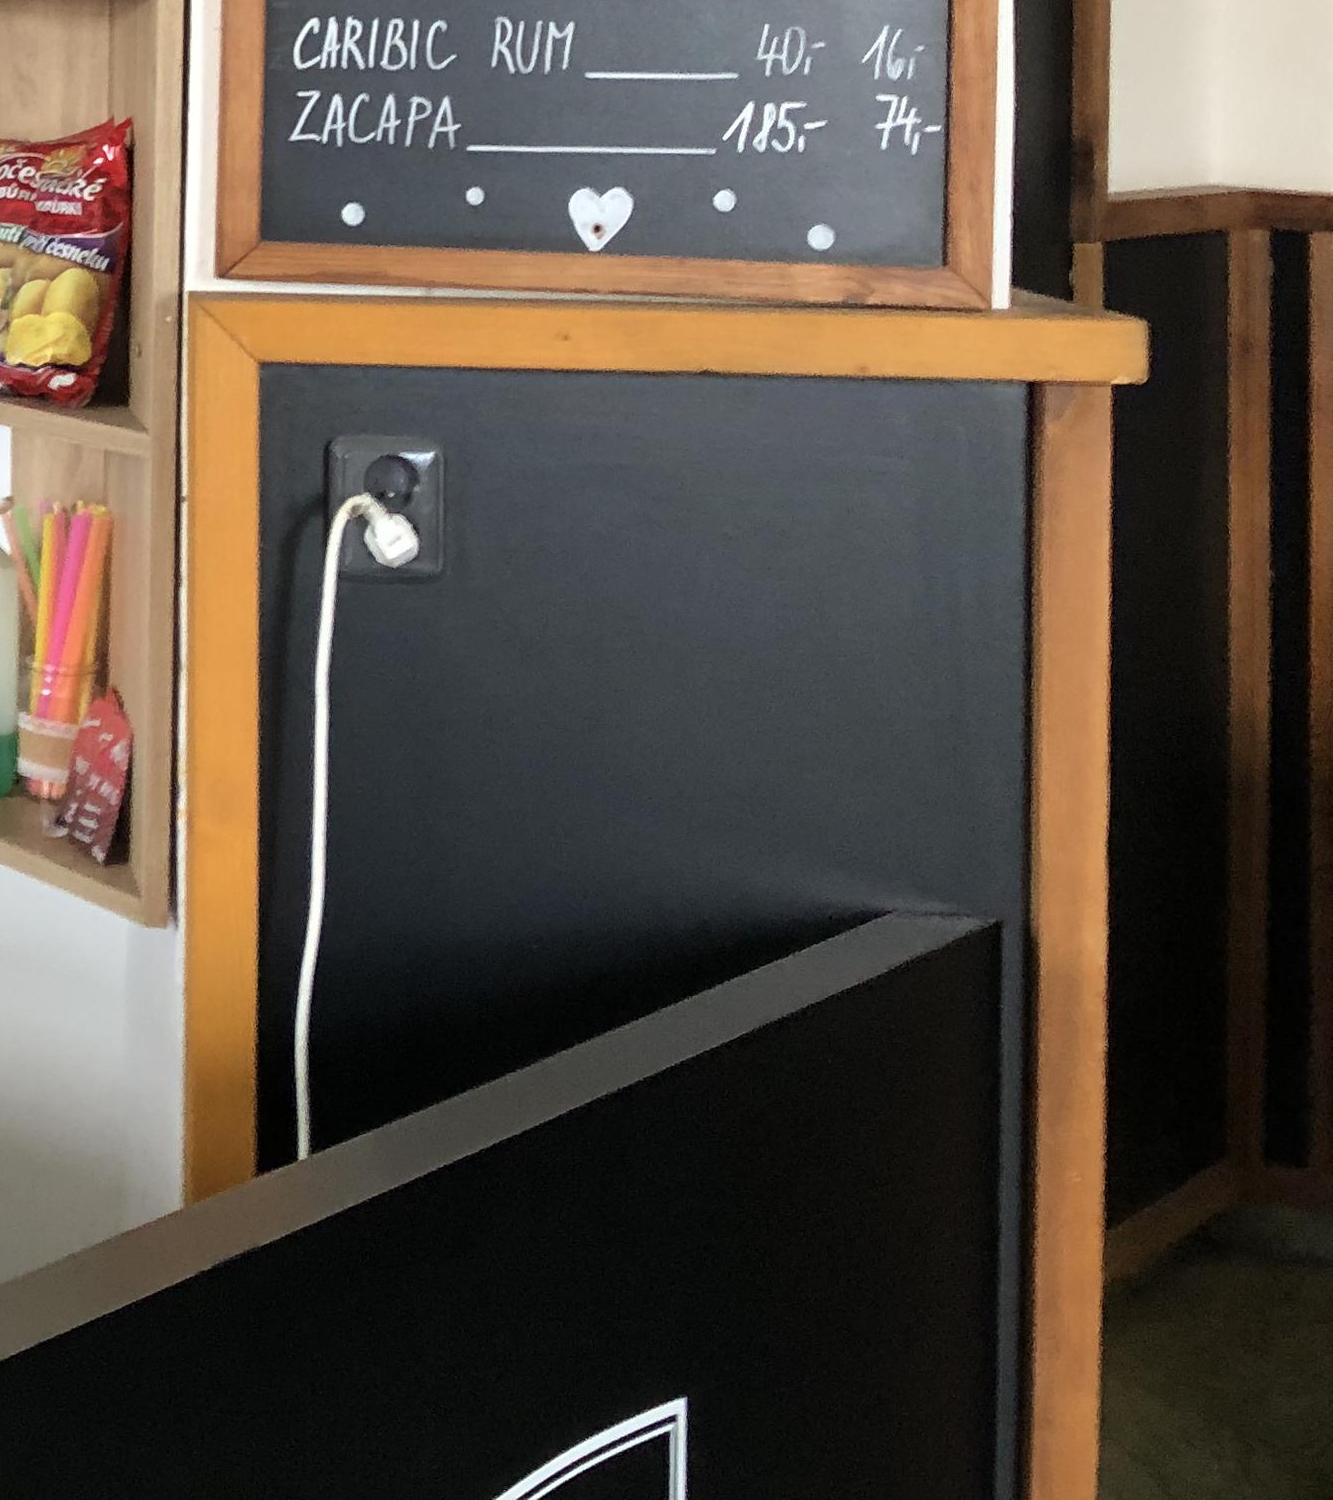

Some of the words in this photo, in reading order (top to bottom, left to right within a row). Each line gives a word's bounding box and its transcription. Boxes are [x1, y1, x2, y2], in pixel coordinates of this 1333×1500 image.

[293, 16, 457, 72] CARIBIC
[491, 20, 576, 73] RUM
[289, 91, 462, 148] ZACAPA
